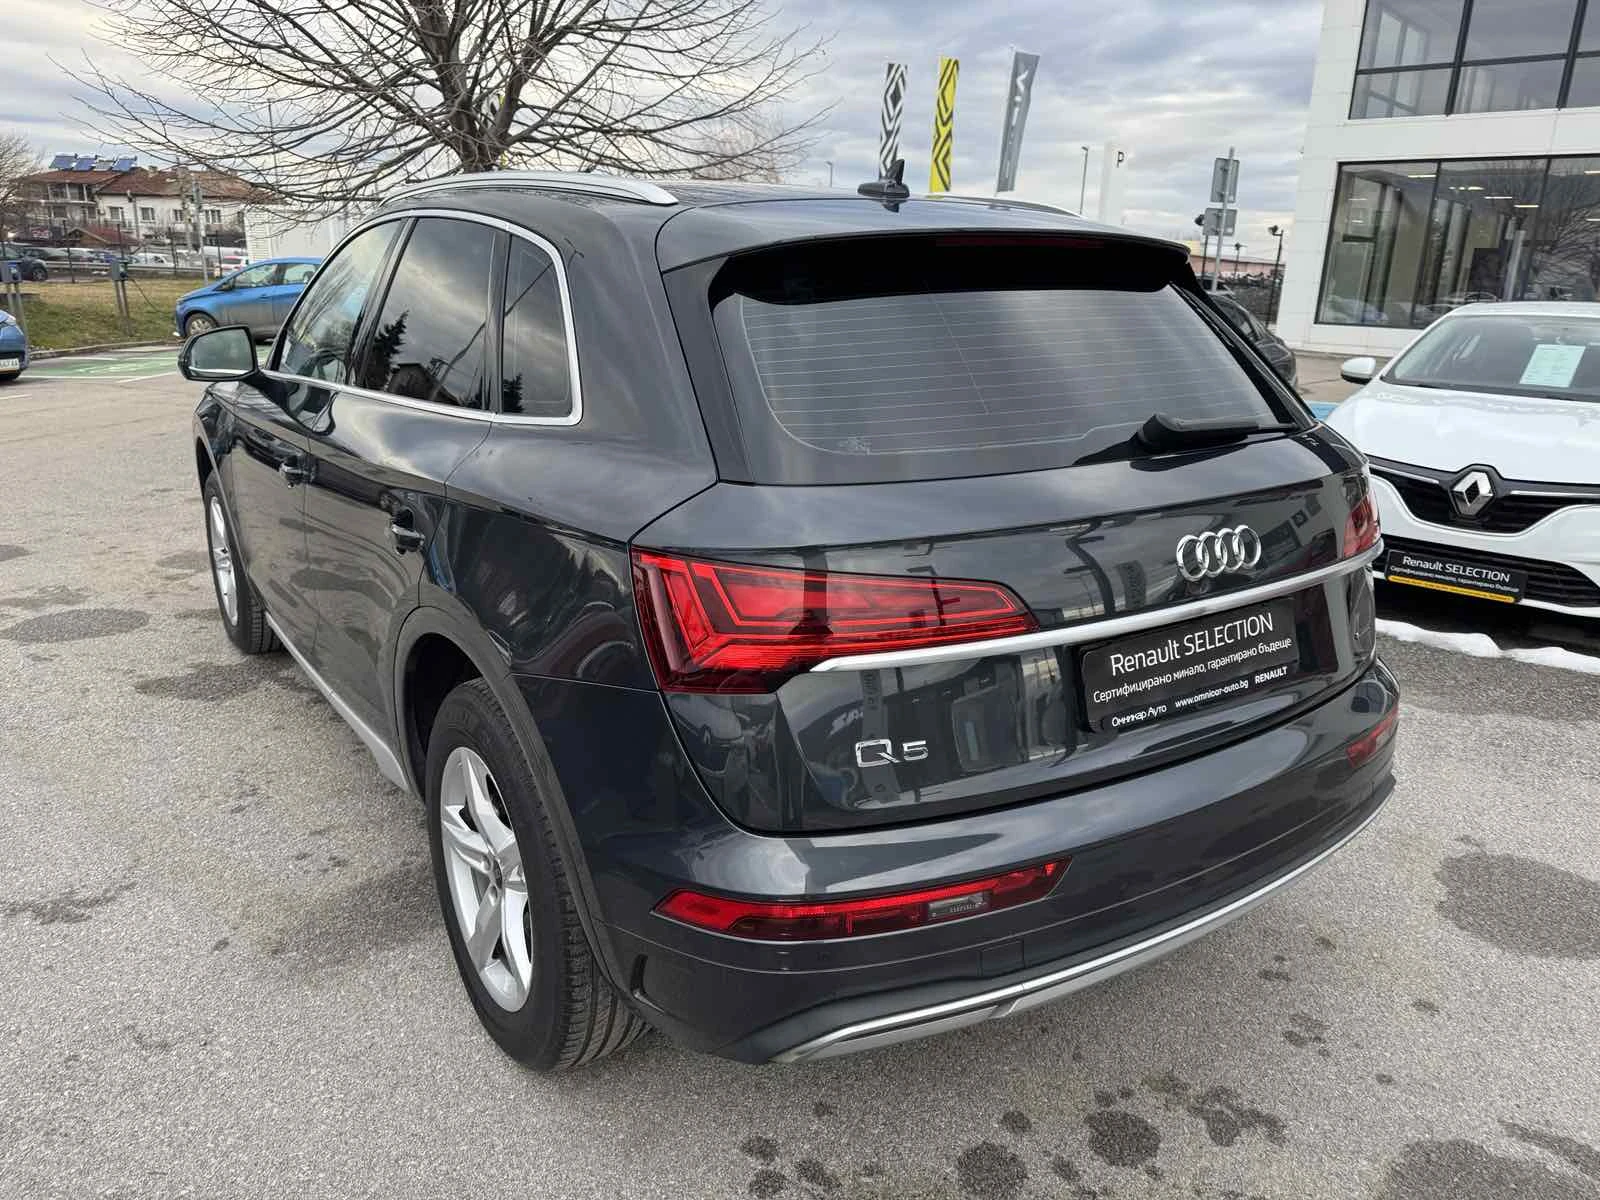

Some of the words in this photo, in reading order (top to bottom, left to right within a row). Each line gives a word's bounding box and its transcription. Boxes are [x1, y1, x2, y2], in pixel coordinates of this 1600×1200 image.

[1402, 556, 1442, 571] Renault
[1445, 563, 1511, 583] SELECTION
[1110, 639, 1180, 676] Renault
[1183, 612, 1273, 656] SELECTION
[1093, 674, 1172, 703] Сертифицирано
[1173, 663, 1207, 681] минало,
[1207, 647, 1257, 670] гарантирано
[1258, 638, 1293, 655] бъдеще
[1254, 666, 1288, 684] RENAULT
[1174, 680, 1249, 708] www.omnicar-auto.bg
[1147, 704, 1167, 717] Ауто
